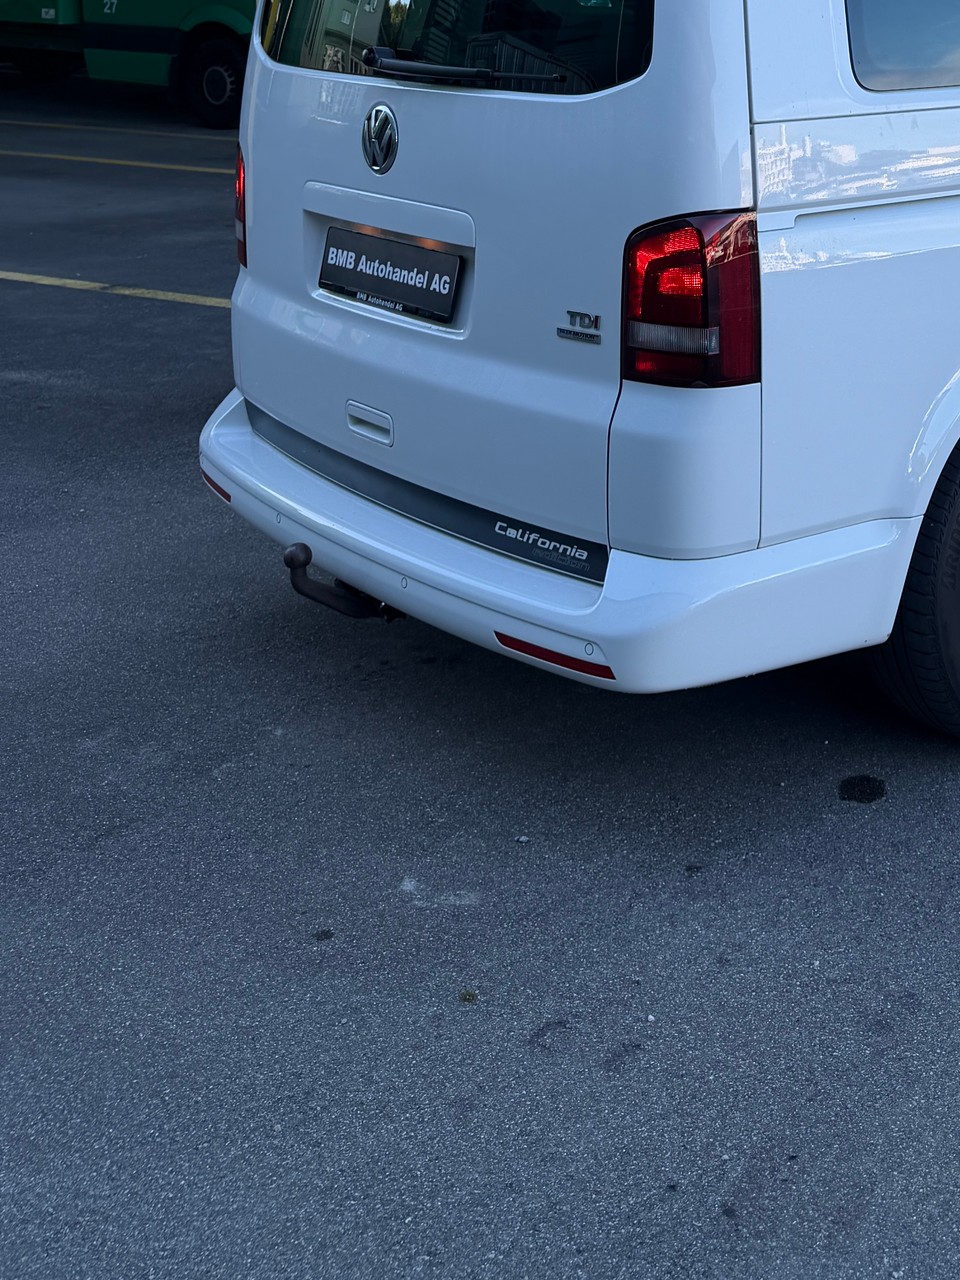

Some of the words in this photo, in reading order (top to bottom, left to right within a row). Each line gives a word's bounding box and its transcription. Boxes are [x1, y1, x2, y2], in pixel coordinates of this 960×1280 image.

[327, 247, 356, 269] BMB
[357, 255, 430, 289] Autohandel
[430, 273, 451, 294] AG
[356, 291, 368, 302] BMB
[368, 294, 395, 309] Autohandel
[394, 303, 404, 311] AG
[566, 310, 602, 331] TDI
[494, 521, 589, 560] California
